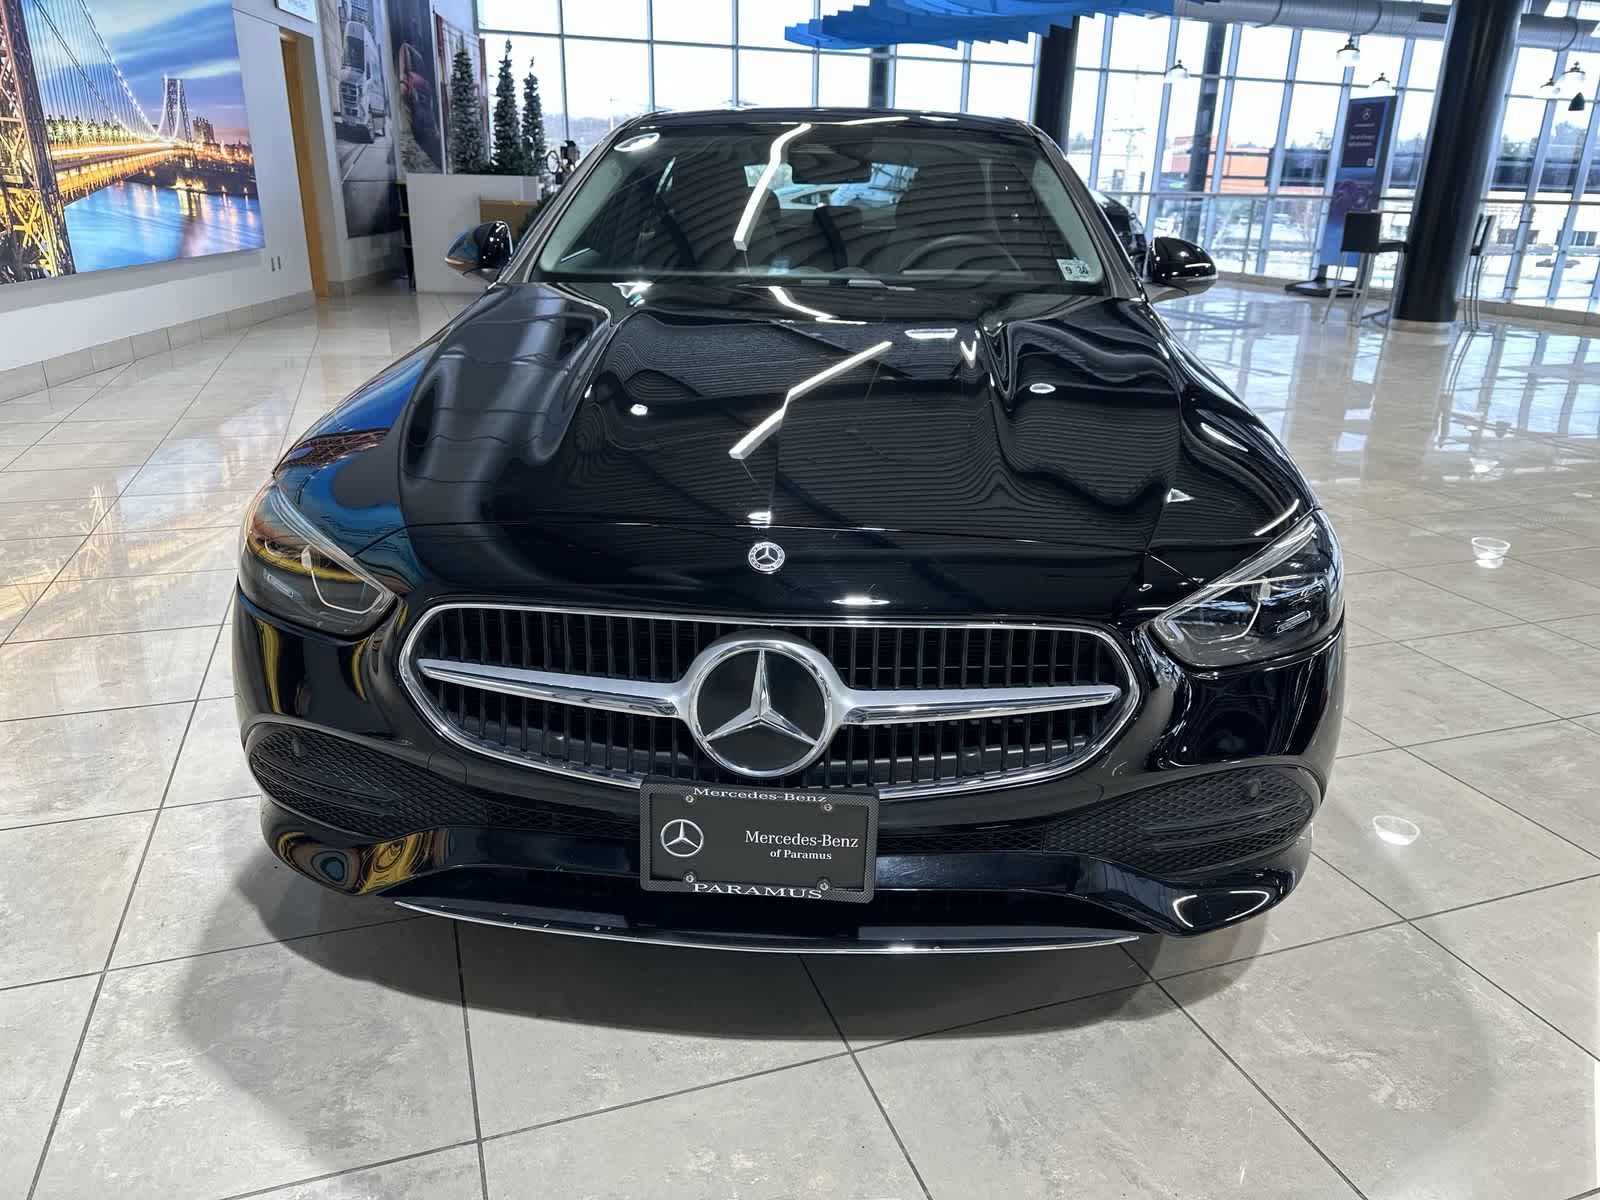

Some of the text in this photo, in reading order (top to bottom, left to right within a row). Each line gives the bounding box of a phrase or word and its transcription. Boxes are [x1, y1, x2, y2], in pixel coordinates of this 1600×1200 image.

[693, 787, 828, 803] Mercedes-Benz
[744, 830, 859, 848] Mercedes-Benz
[770, 849, 832, 860] of Paramus
[693, 883, 822, 899] PARAMUS
